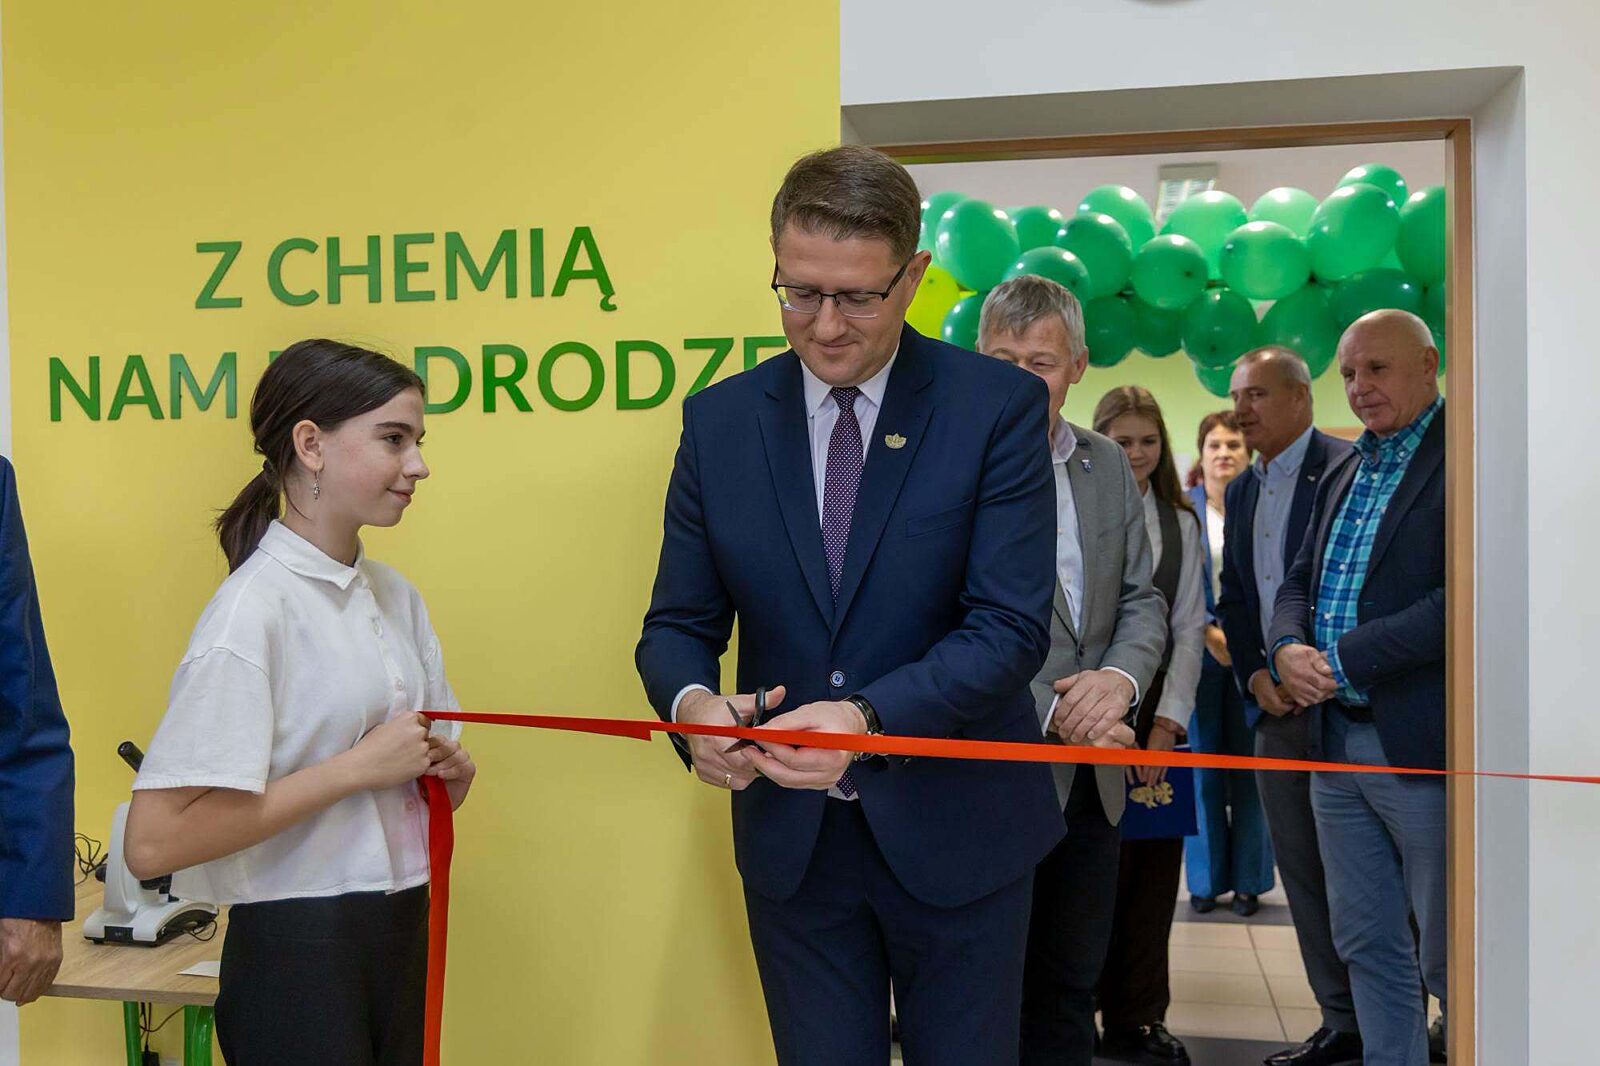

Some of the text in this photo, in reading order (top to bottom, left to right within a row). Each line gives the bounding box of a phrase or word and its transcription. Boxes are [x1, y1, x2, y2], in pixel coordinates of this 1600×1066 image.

[195, 226, 618, 312] Z CHEMIĄ
[49, 351, 238, 422] NAM
